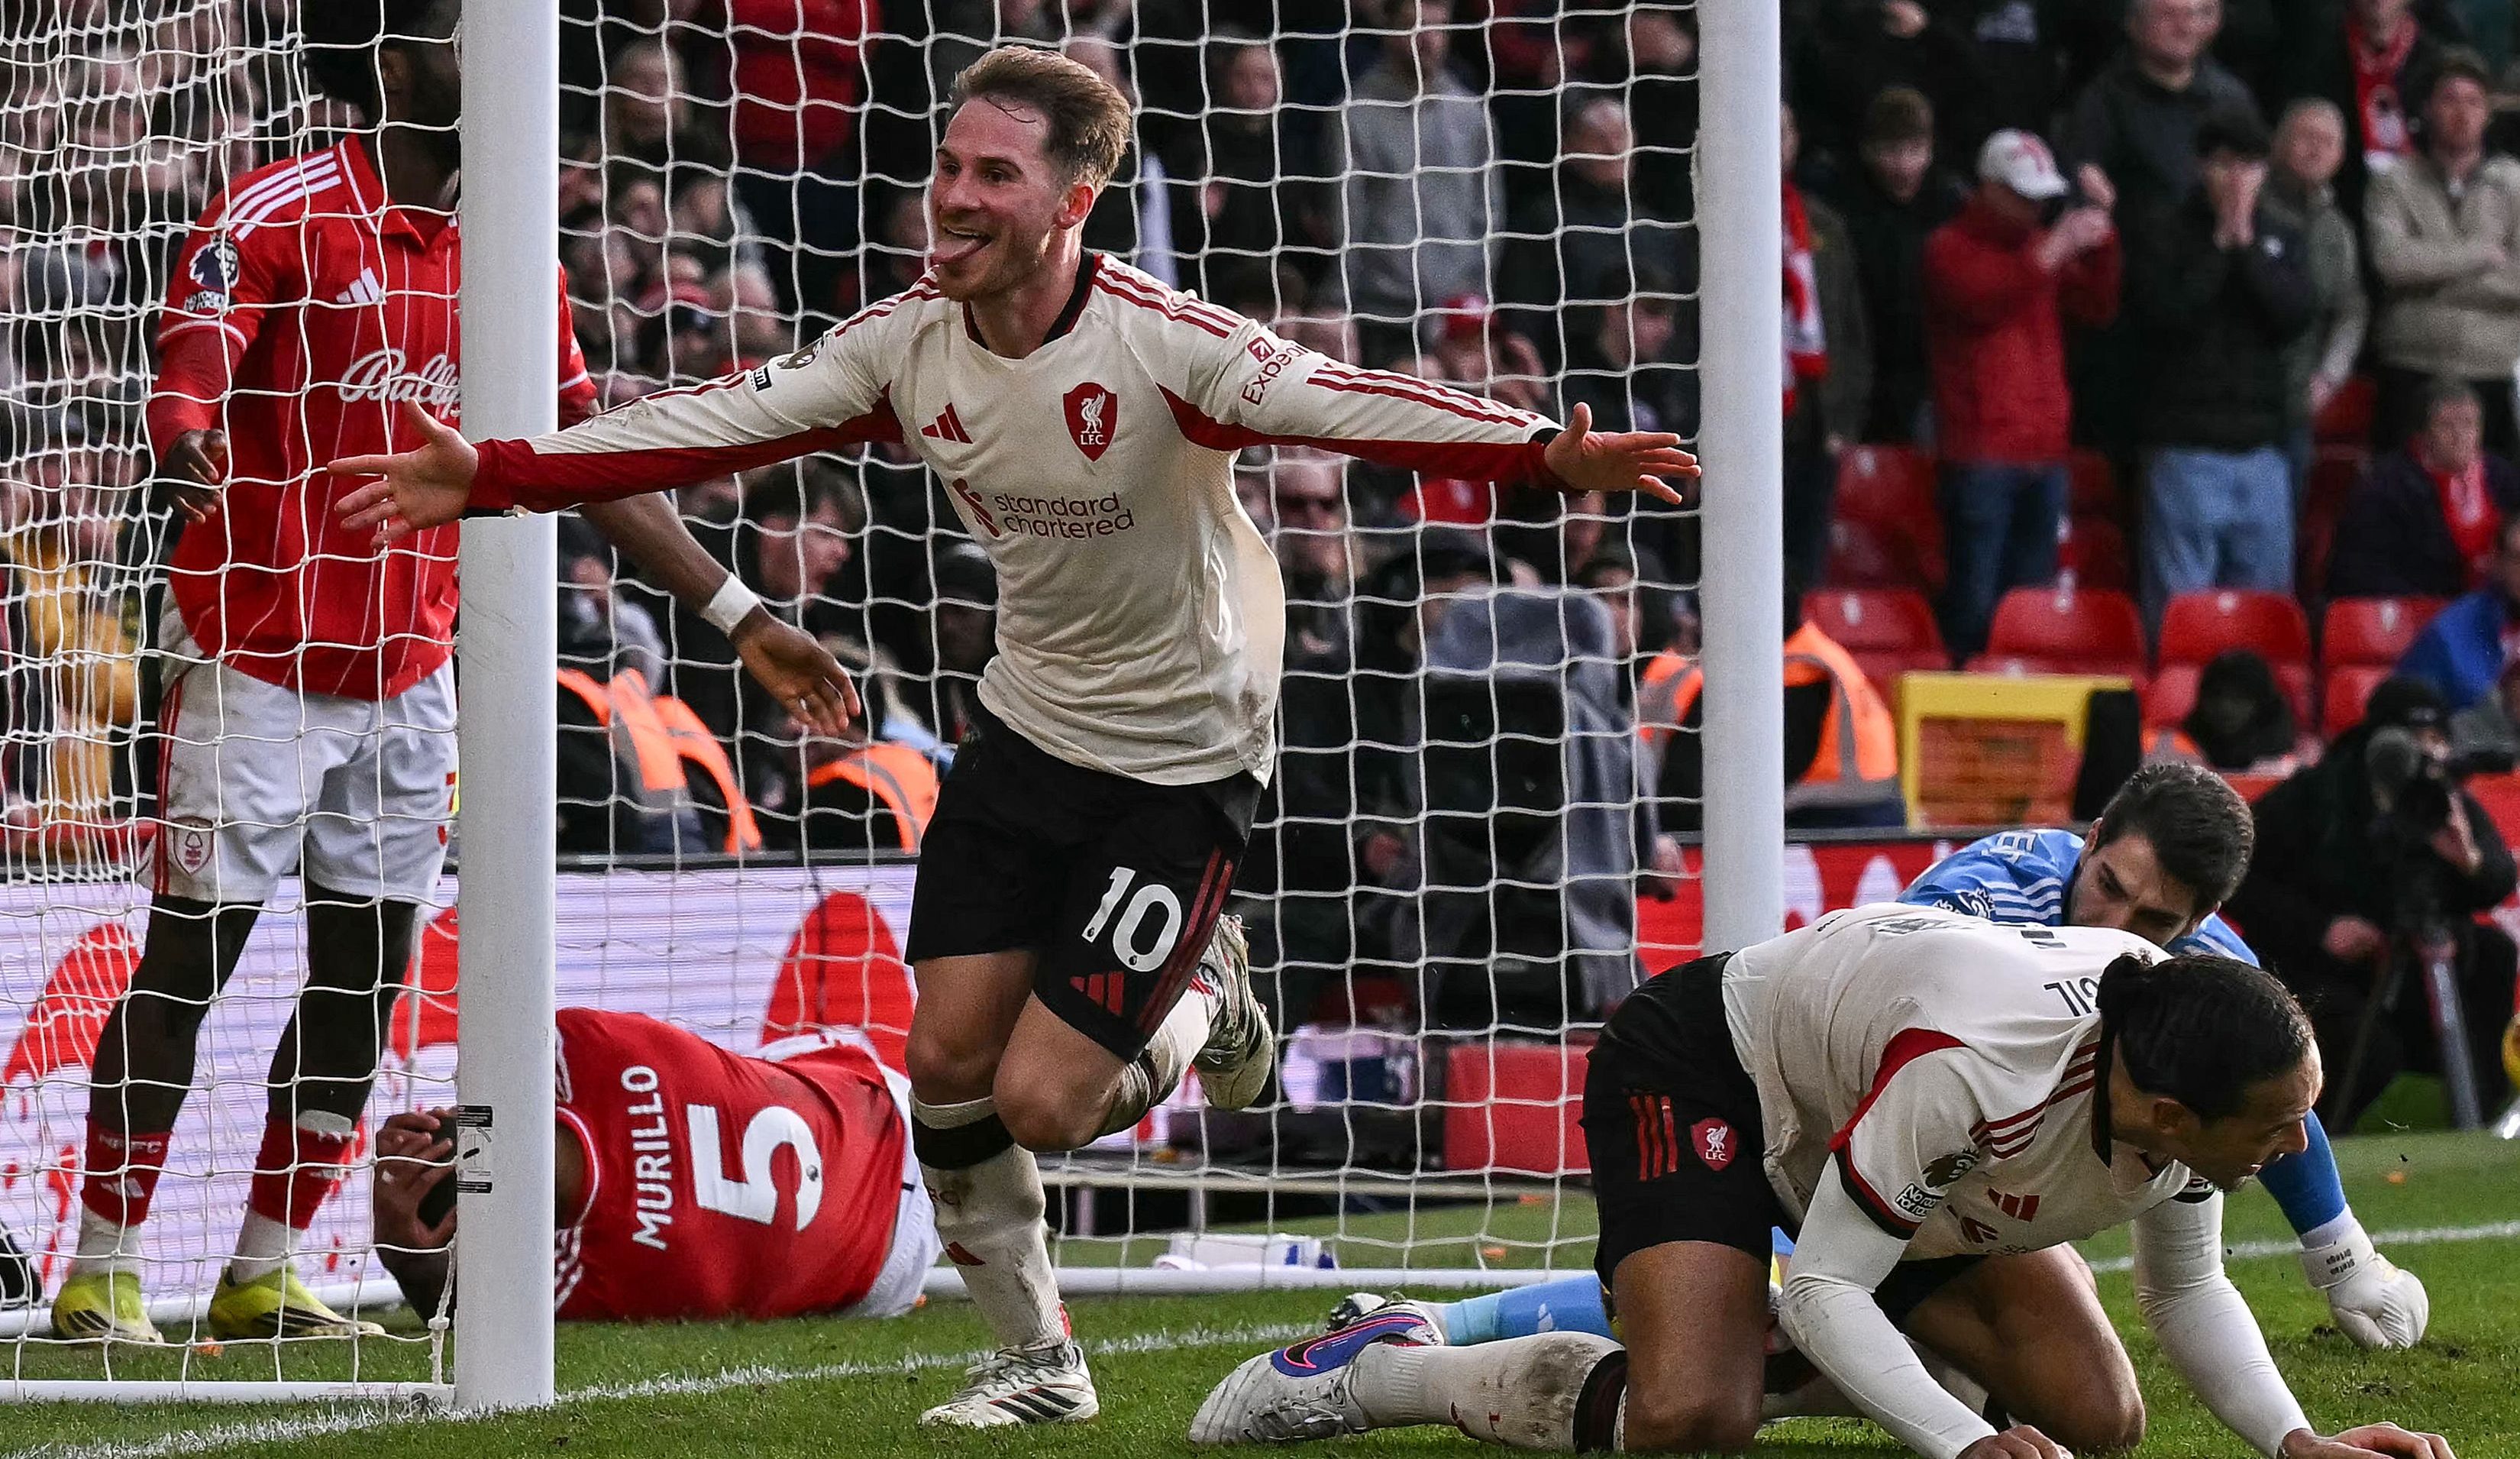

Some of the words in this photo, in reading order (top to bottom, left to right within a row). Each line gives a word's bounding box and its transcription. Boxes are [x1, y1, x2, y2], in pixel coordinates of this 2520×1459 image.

[338, 348, 461, 419] Bally
[1242, 343, 1309, 406] Expedi
[994, 491, 1120, 516] standard
[1004, 509, 1135, 539] chartered
[1081, 865, 1182, 972] 10
[621, 1065, 674, 1251] MURILLO
[687, 1103, 823, 1231] 5
[1904, 1185, 1923, 1202] No
